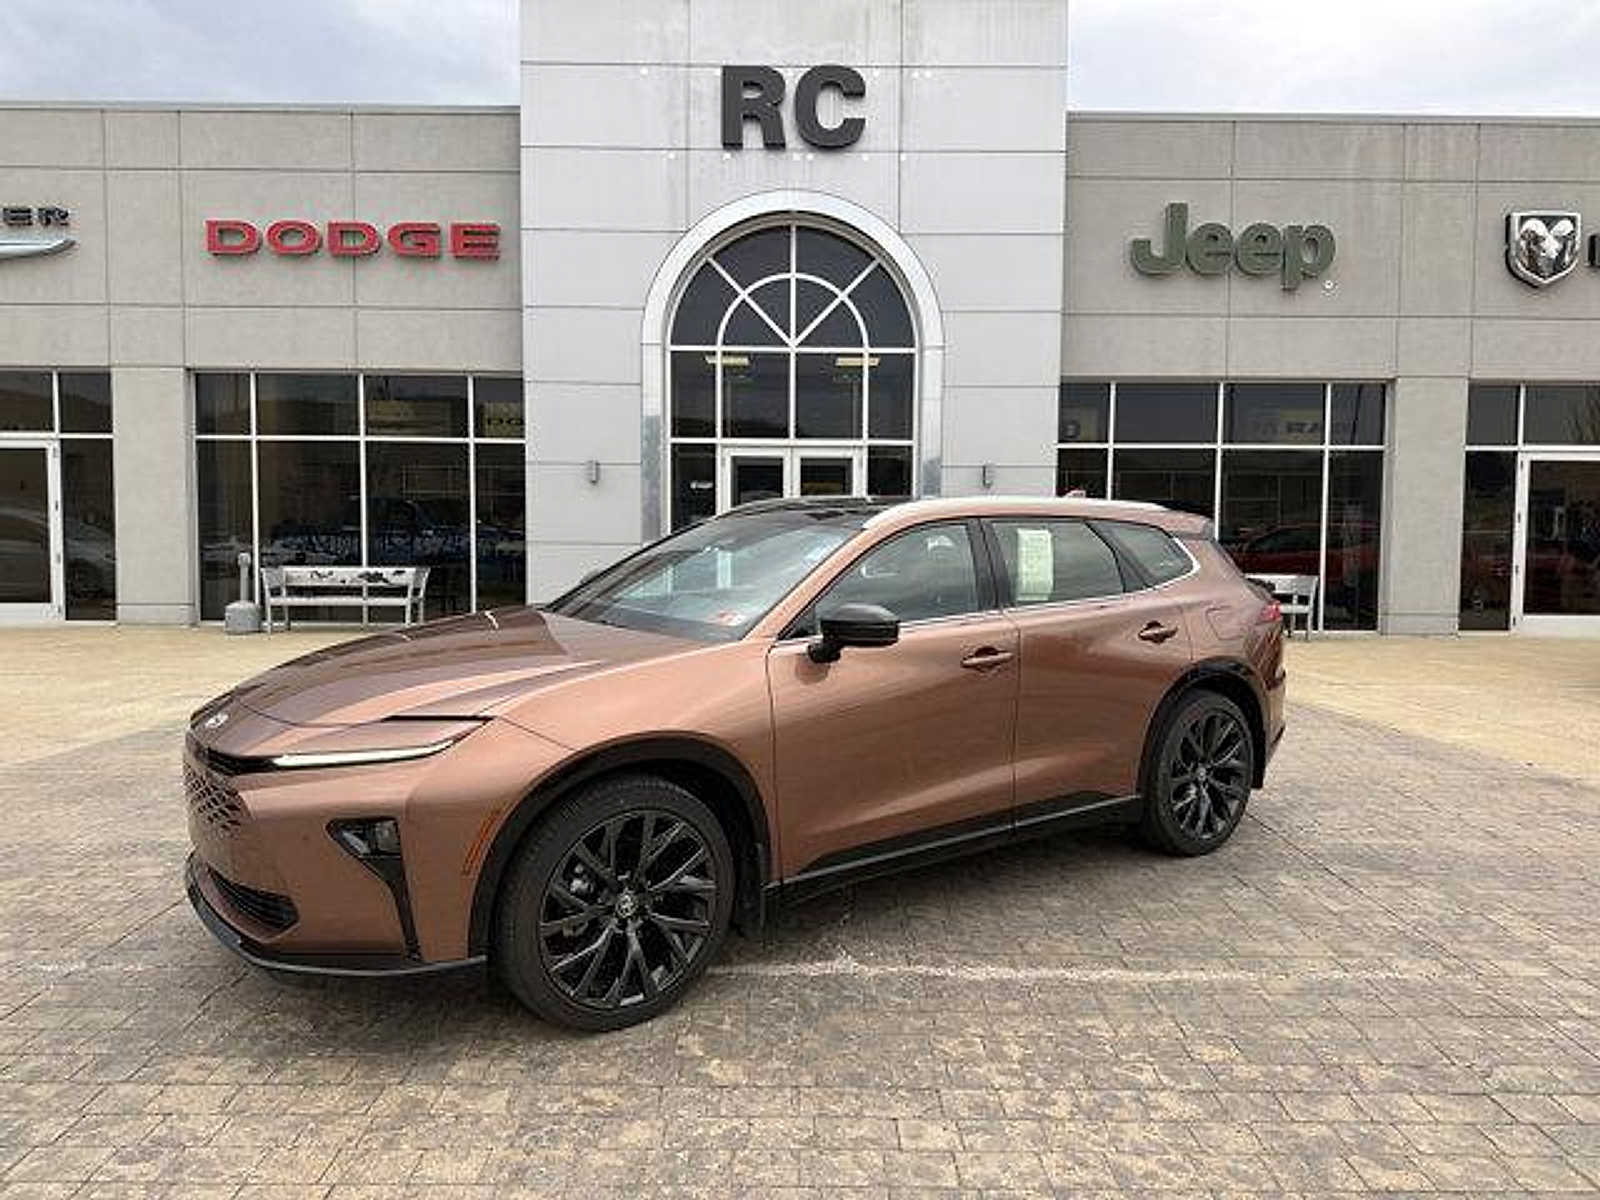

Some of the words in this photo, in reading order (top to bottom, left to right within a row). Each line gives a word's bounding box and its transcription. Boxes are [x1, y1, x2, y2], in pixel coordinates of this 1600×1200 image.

[721, 65, 866, 150] RC
[205, 219, 501, 259] DODGE
[1130, 202, 1336, 291] Jeep
